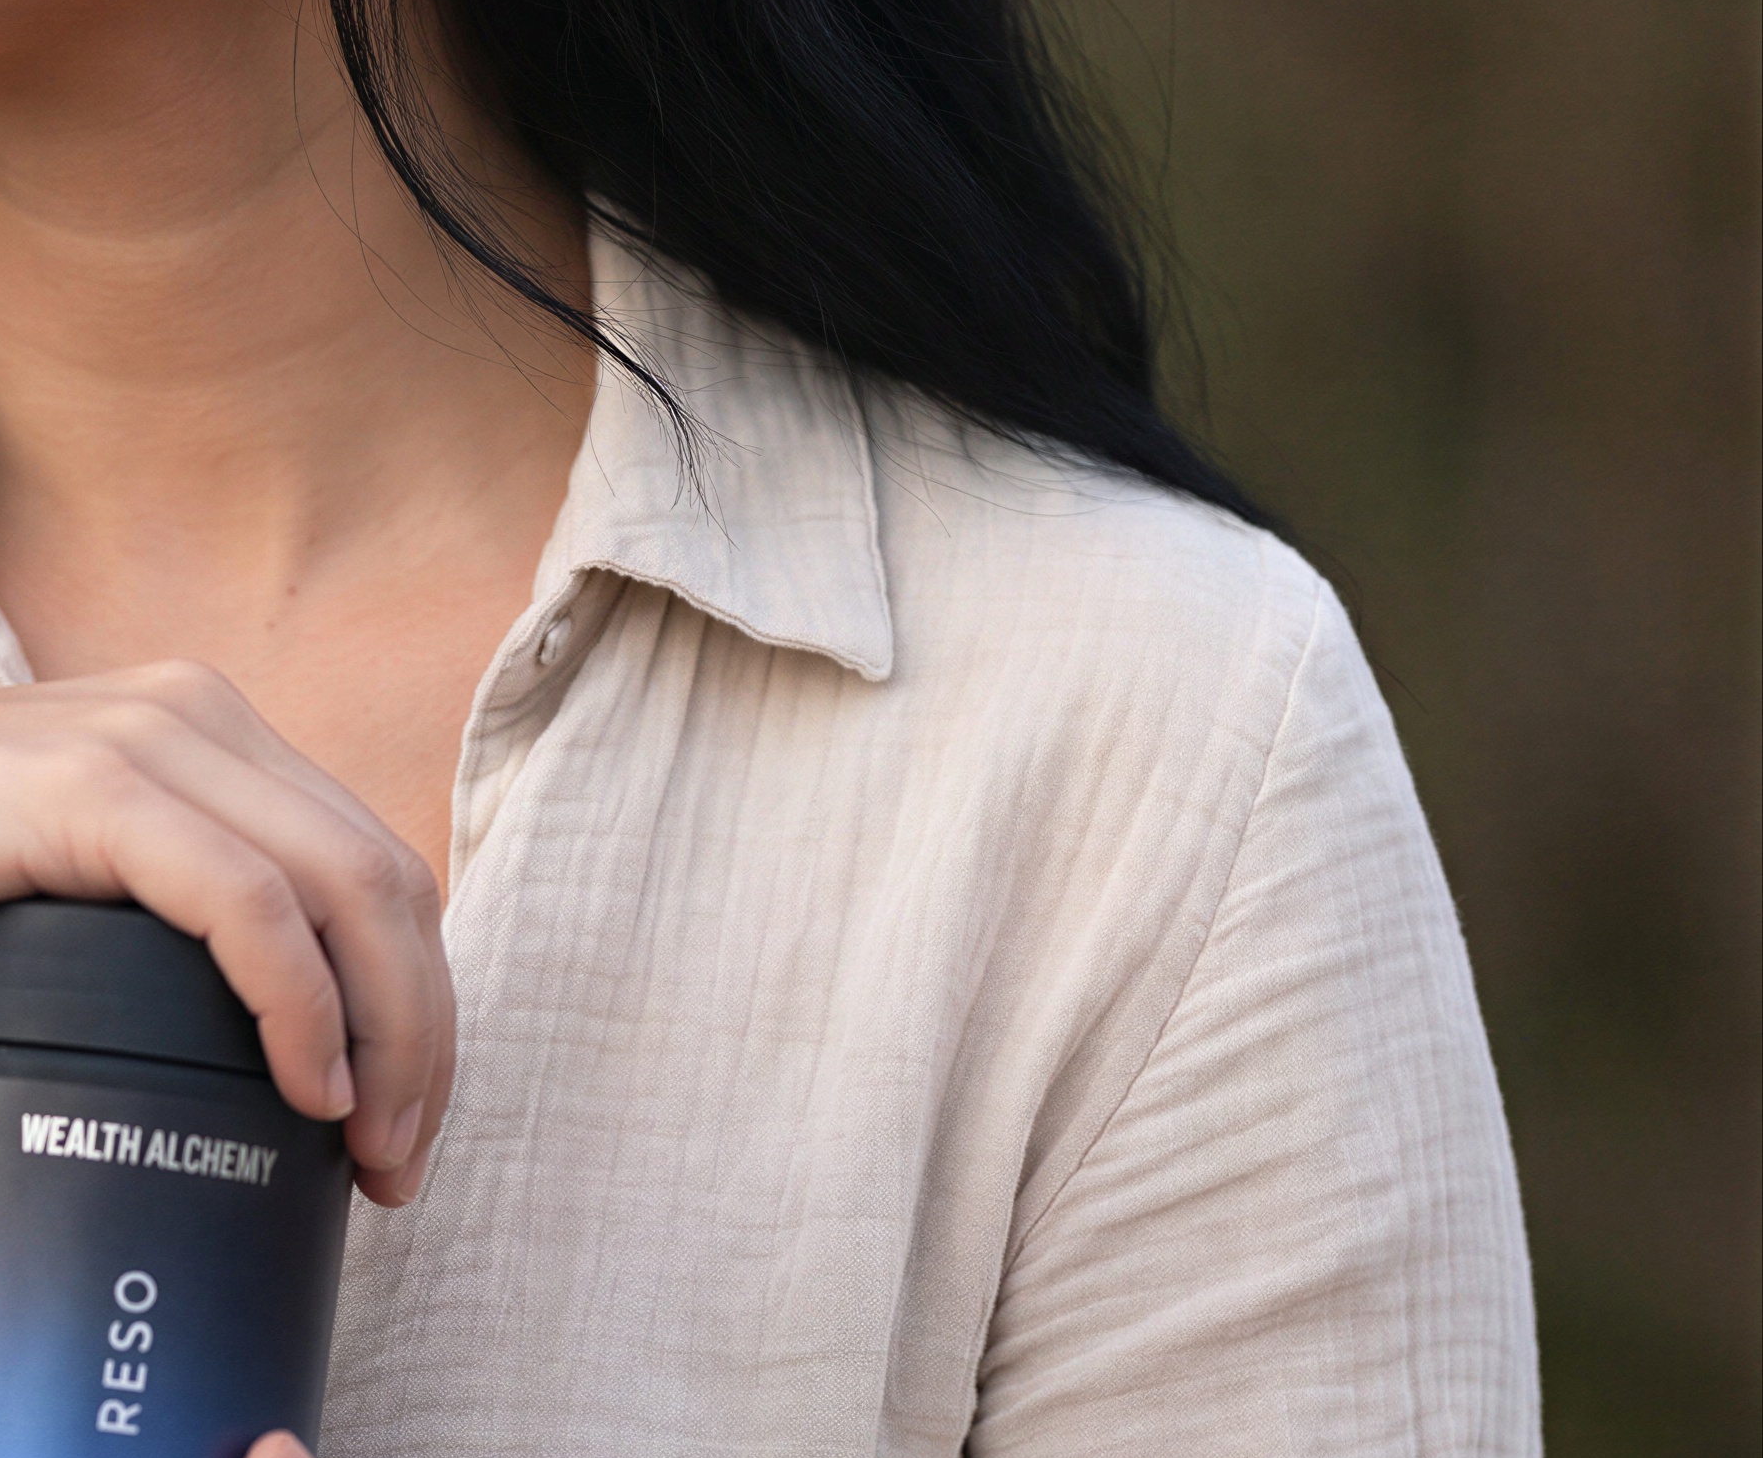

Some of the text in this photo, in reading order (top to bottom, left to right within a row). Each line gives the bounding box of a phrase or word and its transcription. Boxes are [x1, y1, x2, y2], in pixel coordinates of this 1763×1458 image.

[21, 1112, 278, 1187] WEALTH ALCHEMY
[95, 1270, 158, 1436] RESO
